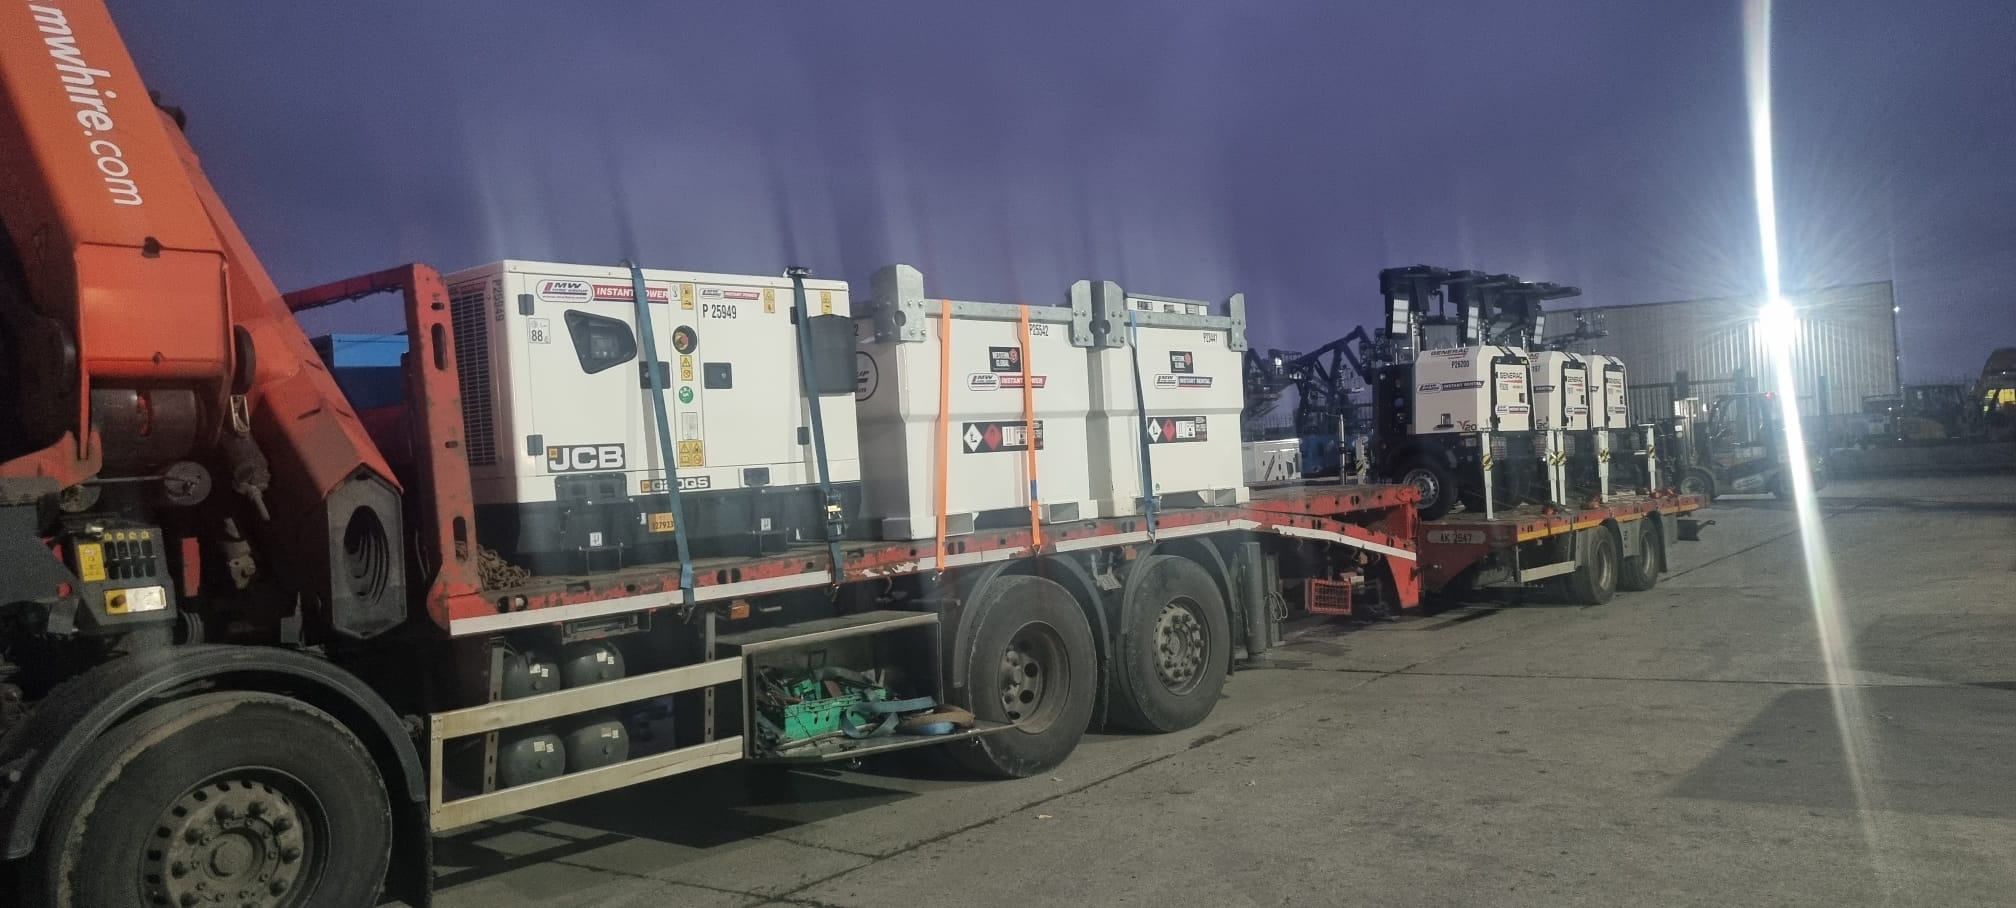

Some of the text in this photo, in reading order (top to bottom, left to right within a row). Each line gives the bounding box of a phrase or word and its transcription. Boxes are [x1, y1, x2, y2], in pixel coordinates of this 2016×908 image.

[596, 287, 634, 297] INSTANT
[702, 303, 737, 319] P 25949
[531, 329, 544, 342] 88
[1499, 371, 1523, 379] GENERAC
[550, 446, 624, 471] JCB
